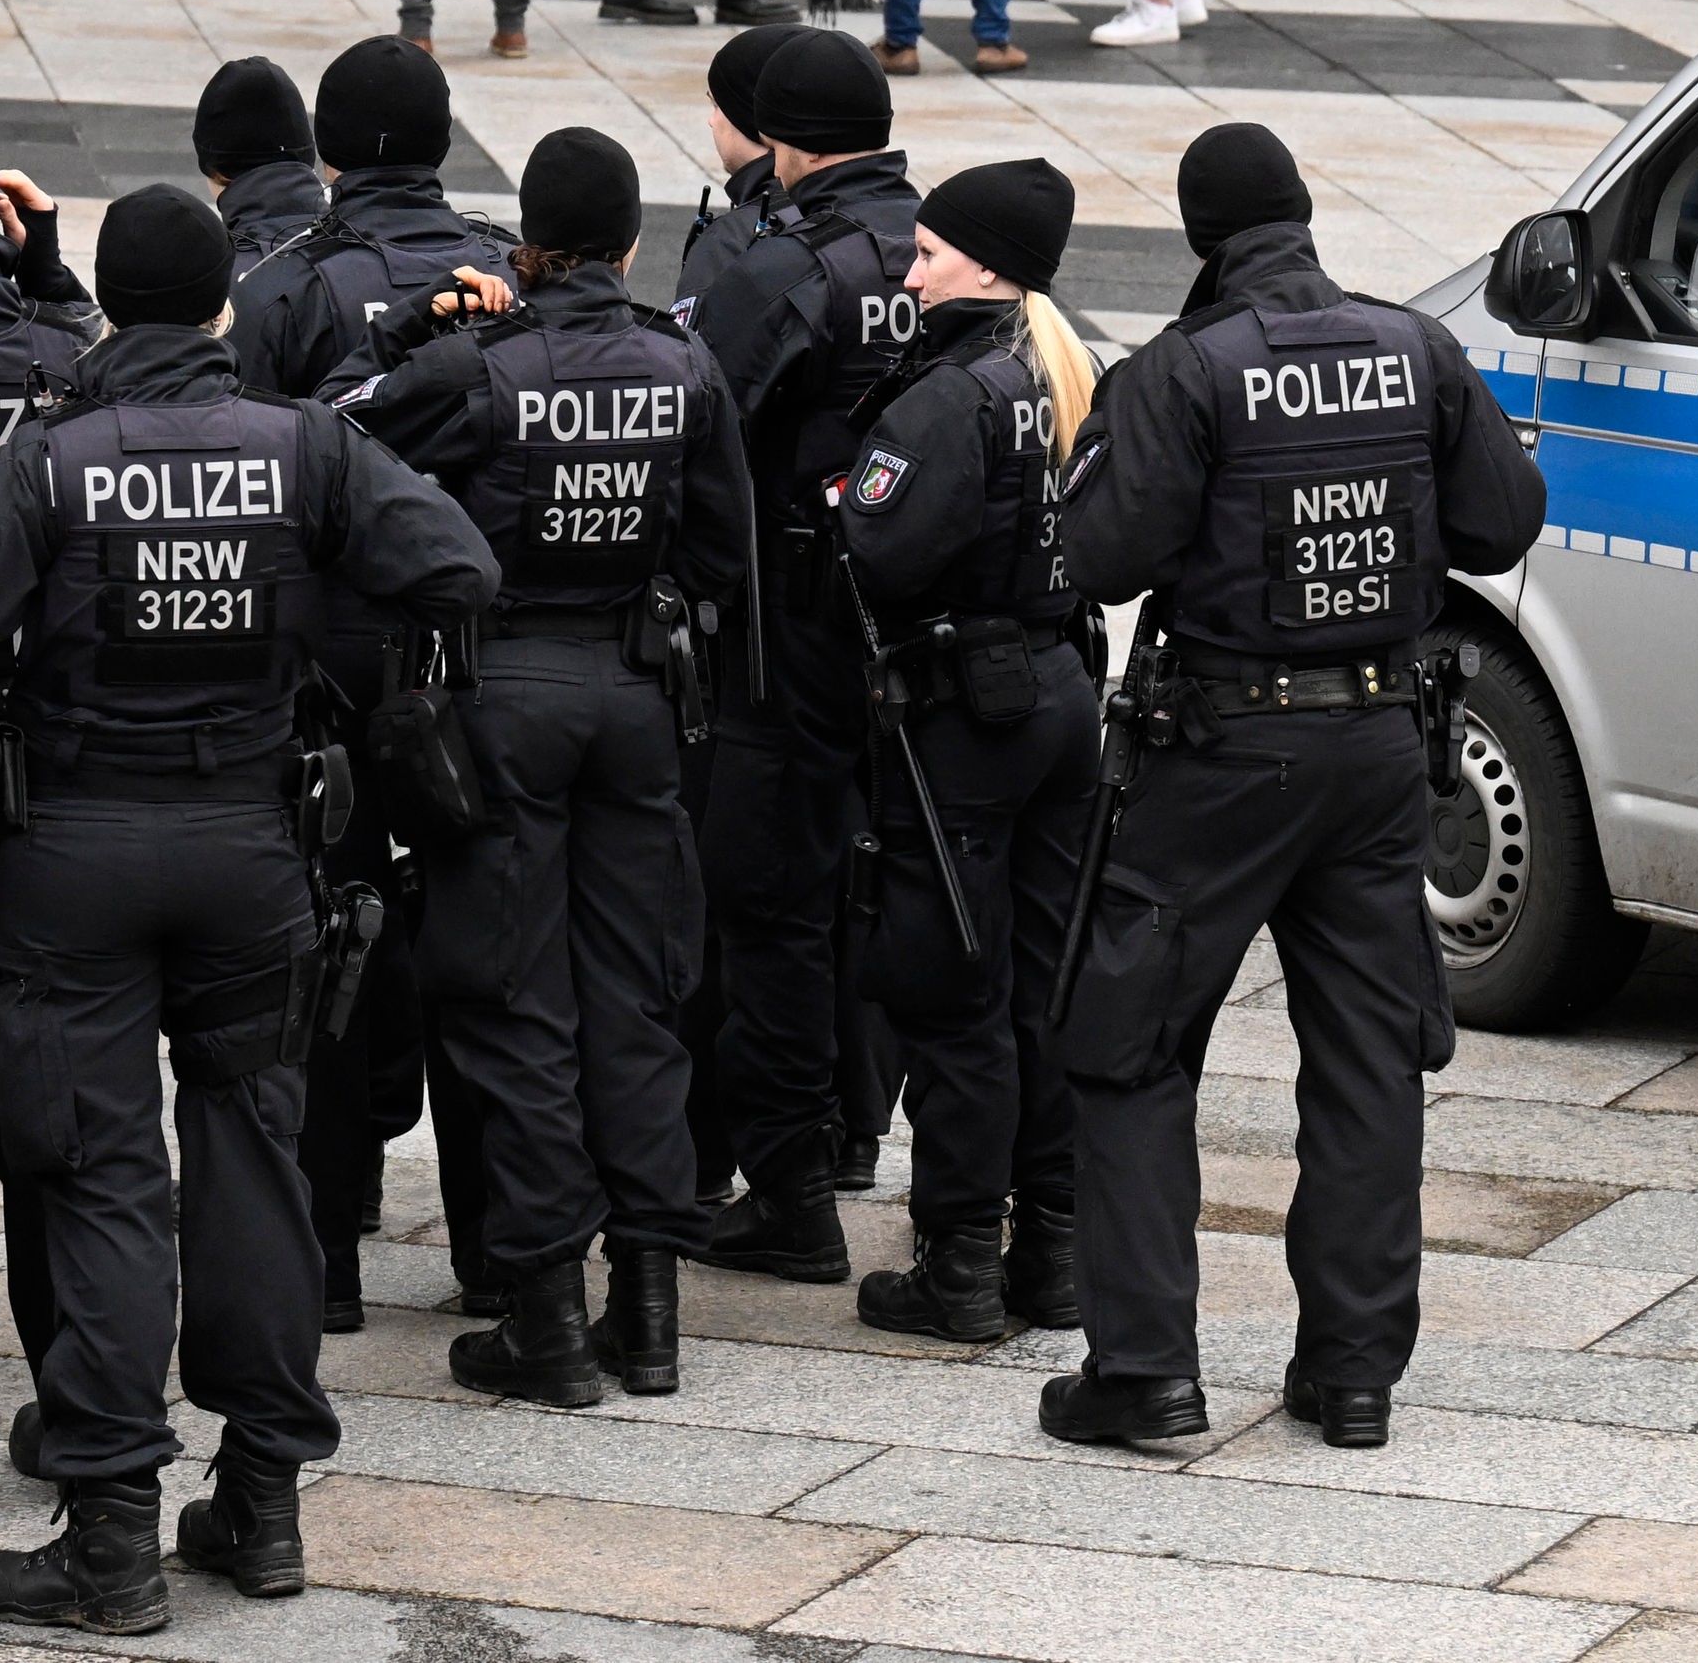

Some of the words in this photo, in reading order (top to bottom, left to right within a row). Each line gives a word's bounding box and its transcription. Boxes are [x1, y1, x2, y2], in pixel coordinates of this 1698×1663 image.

[1243, 354, 1416, 421] POLIZEI
[517, 385, 685, 442] POLIZEI
[84, 459, 283, 522] POLIZEI
[554, 460, 651, 500] NRW
[1293, 478, 1388, 525] NRW
[541, 506, 643, 542] 31212
[137, 540, 248, 581] NRW
[1295, 525, 1396, 574] 31213
[137, 589, 252, 630] 31231
[1305, 573, 1390, 620] BeSi
